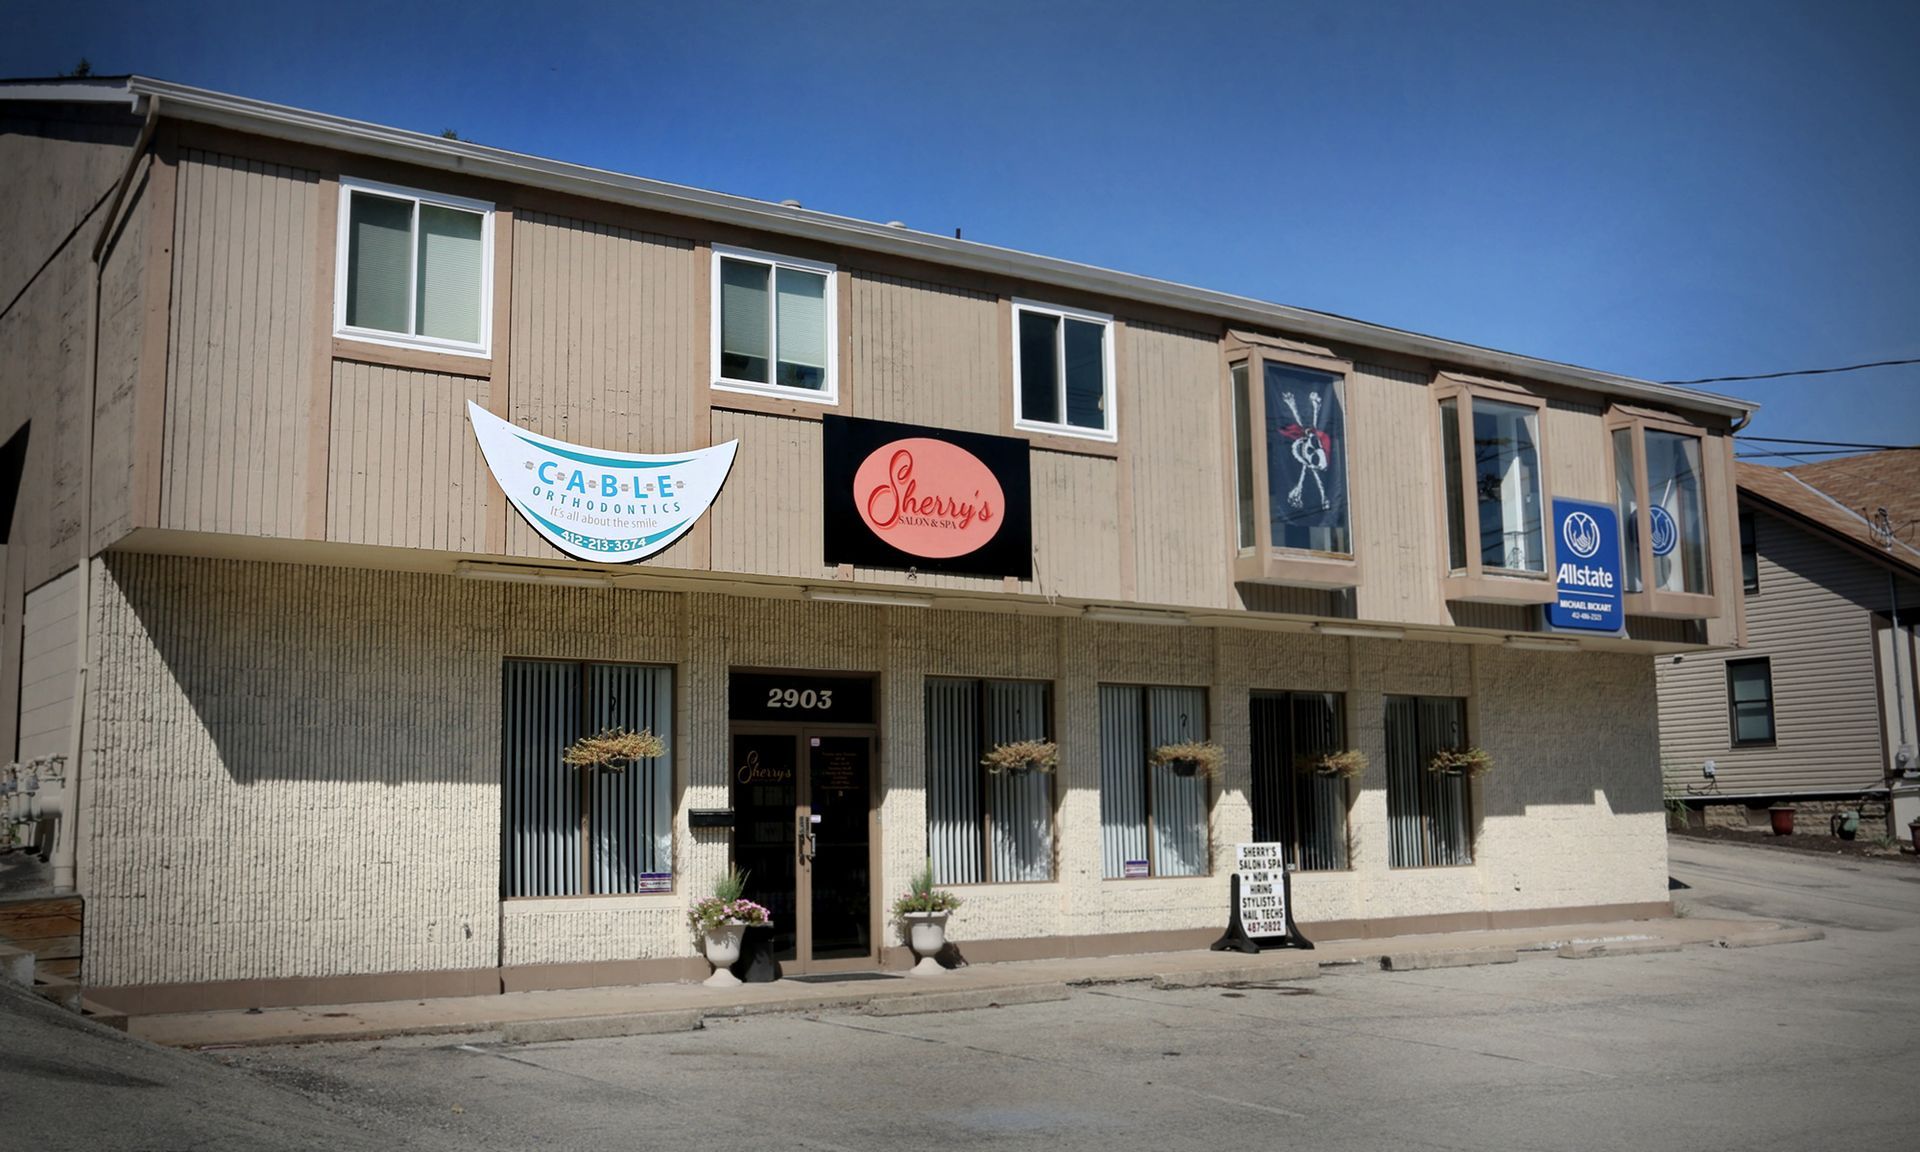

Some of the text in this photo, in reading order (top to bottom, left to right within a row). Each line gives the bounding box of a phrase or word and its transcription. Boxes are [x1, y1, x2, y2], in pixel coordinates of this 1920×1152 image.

[538, 461, 674, 498] CABLE
[867, 449, 994, 530] Sherry's
[533, 486, 681, 515] ORTHODONTICS
[550, 505, 658, 528] It's all about the smile
[898, 516, 957, 530] SALON & SPA
[561, 530, 647, 551] 412-213-3674
[1556, 563, 1613, 588] Allstate
[1560, 599, 1587, 610] MICHAEL
[767, 688, 833, 709] 2903
[738, 750, 792, 784] Sherry's
[1243, 846, 1276, 857] SHERRY'S
[1239, 860, 1261, 870] SALON
[1268, 859, 1281, 869] SPA
[1253, 872, 1268, 882] NOW
[1250, 884, 1272, 894] HIRING
[1242, 896, 1275, 908] STYLISTS
[1243, 908, 1283, 920] NAIL TECHS
[1247, 921, 1281, 932] 487-0822
